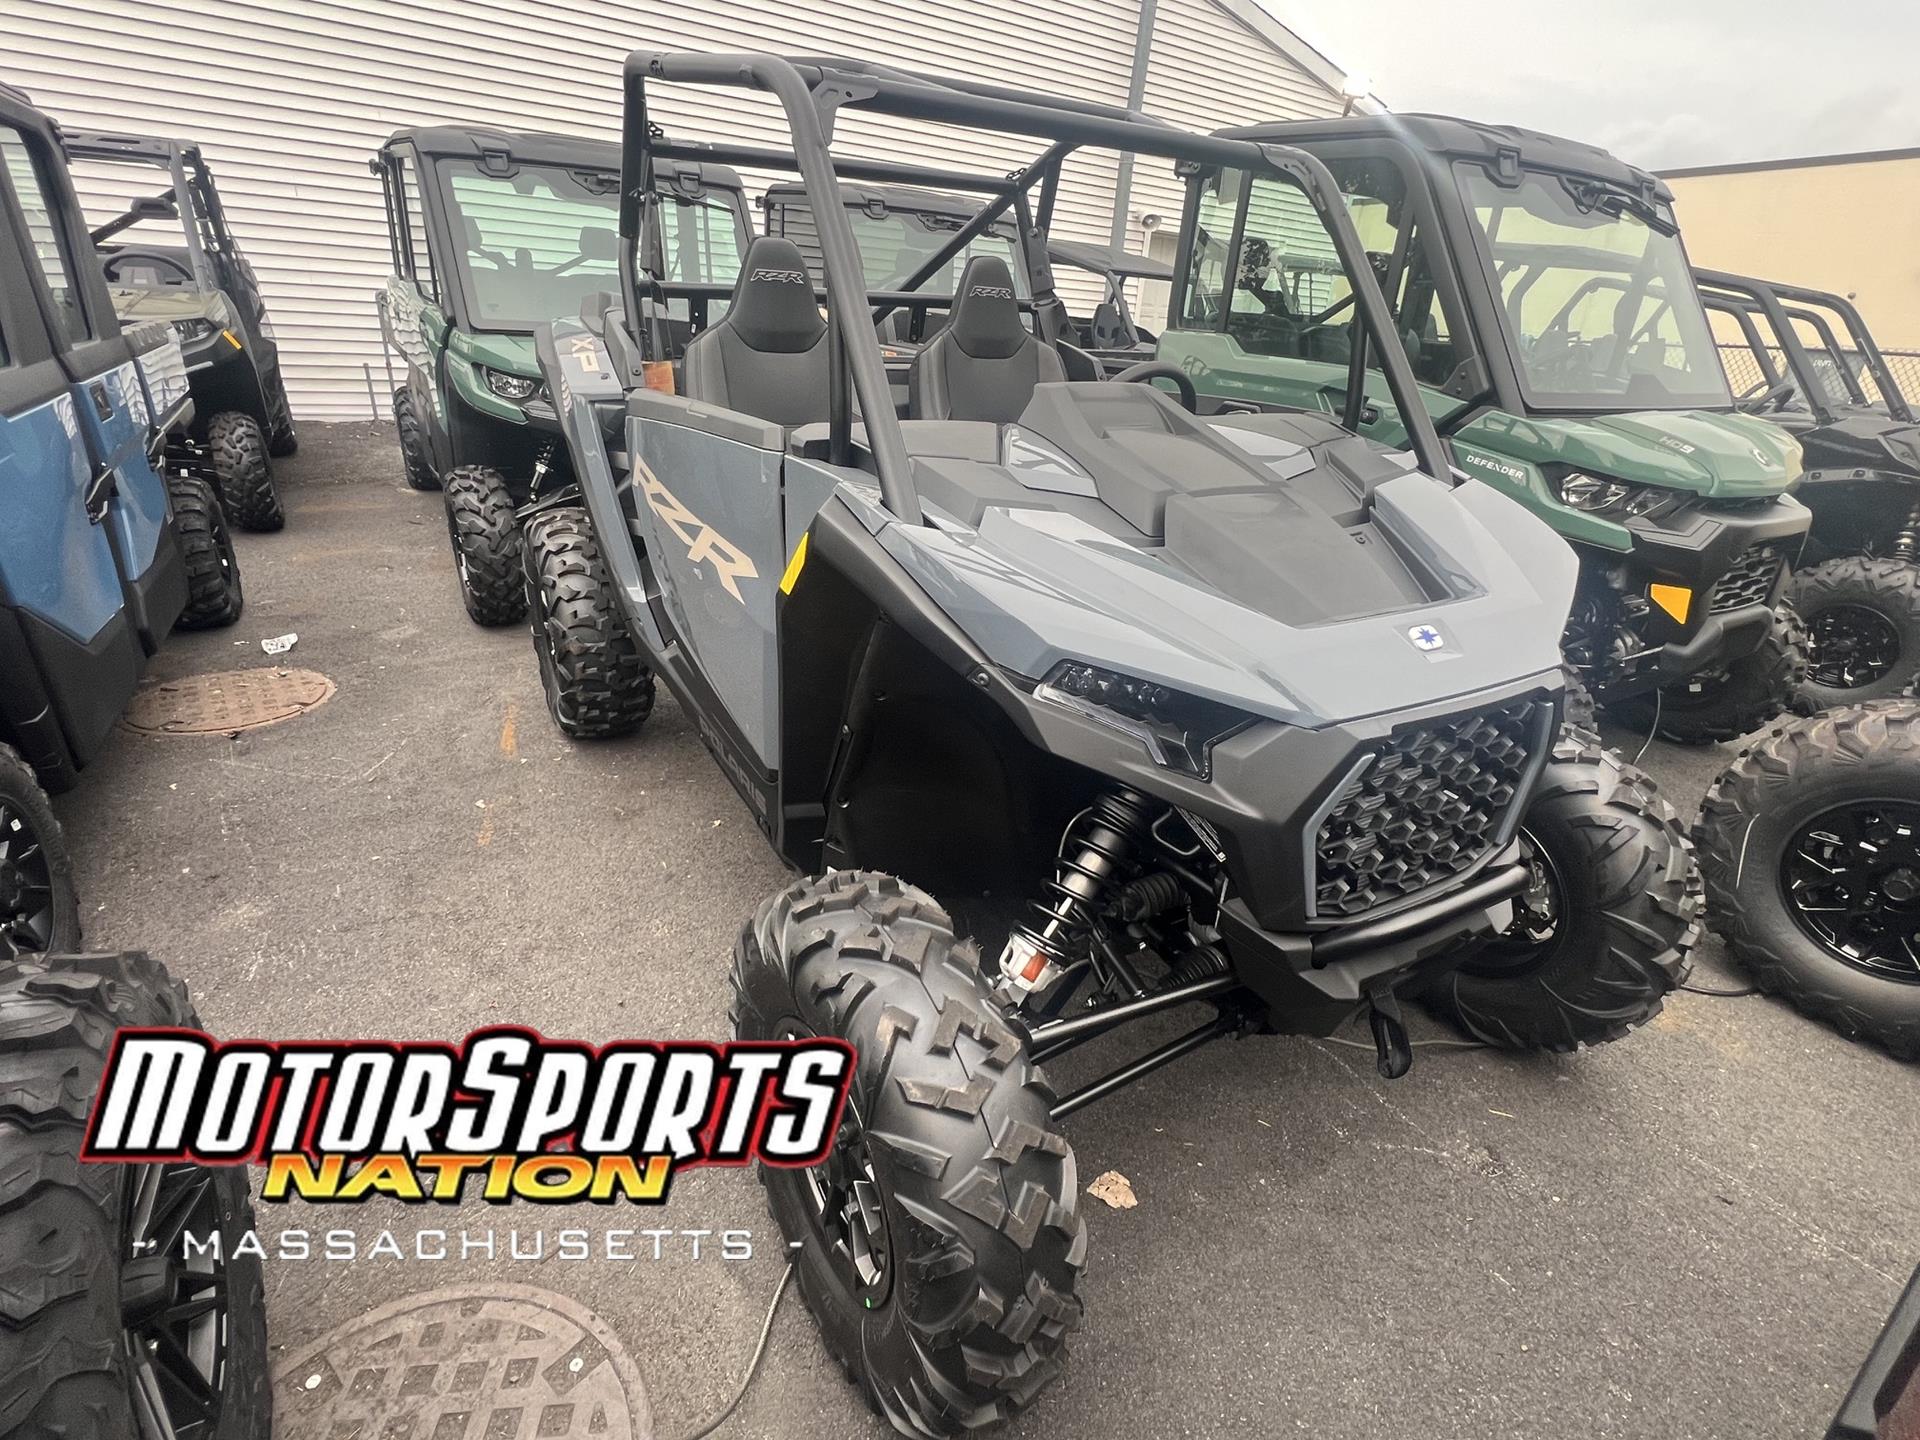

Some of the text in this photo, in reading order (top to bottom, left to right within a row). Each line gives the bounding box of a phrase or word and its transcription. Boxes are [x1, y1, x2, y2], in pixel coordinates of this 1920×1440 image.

[750, 268, 804, 284] RZR
[969, 285, 1012, 299] RZR
[571, 337, 600, 372] XP
[1466, 454, 1524, 479] DEFENDER
[632, 452, 759, 606] RZR
